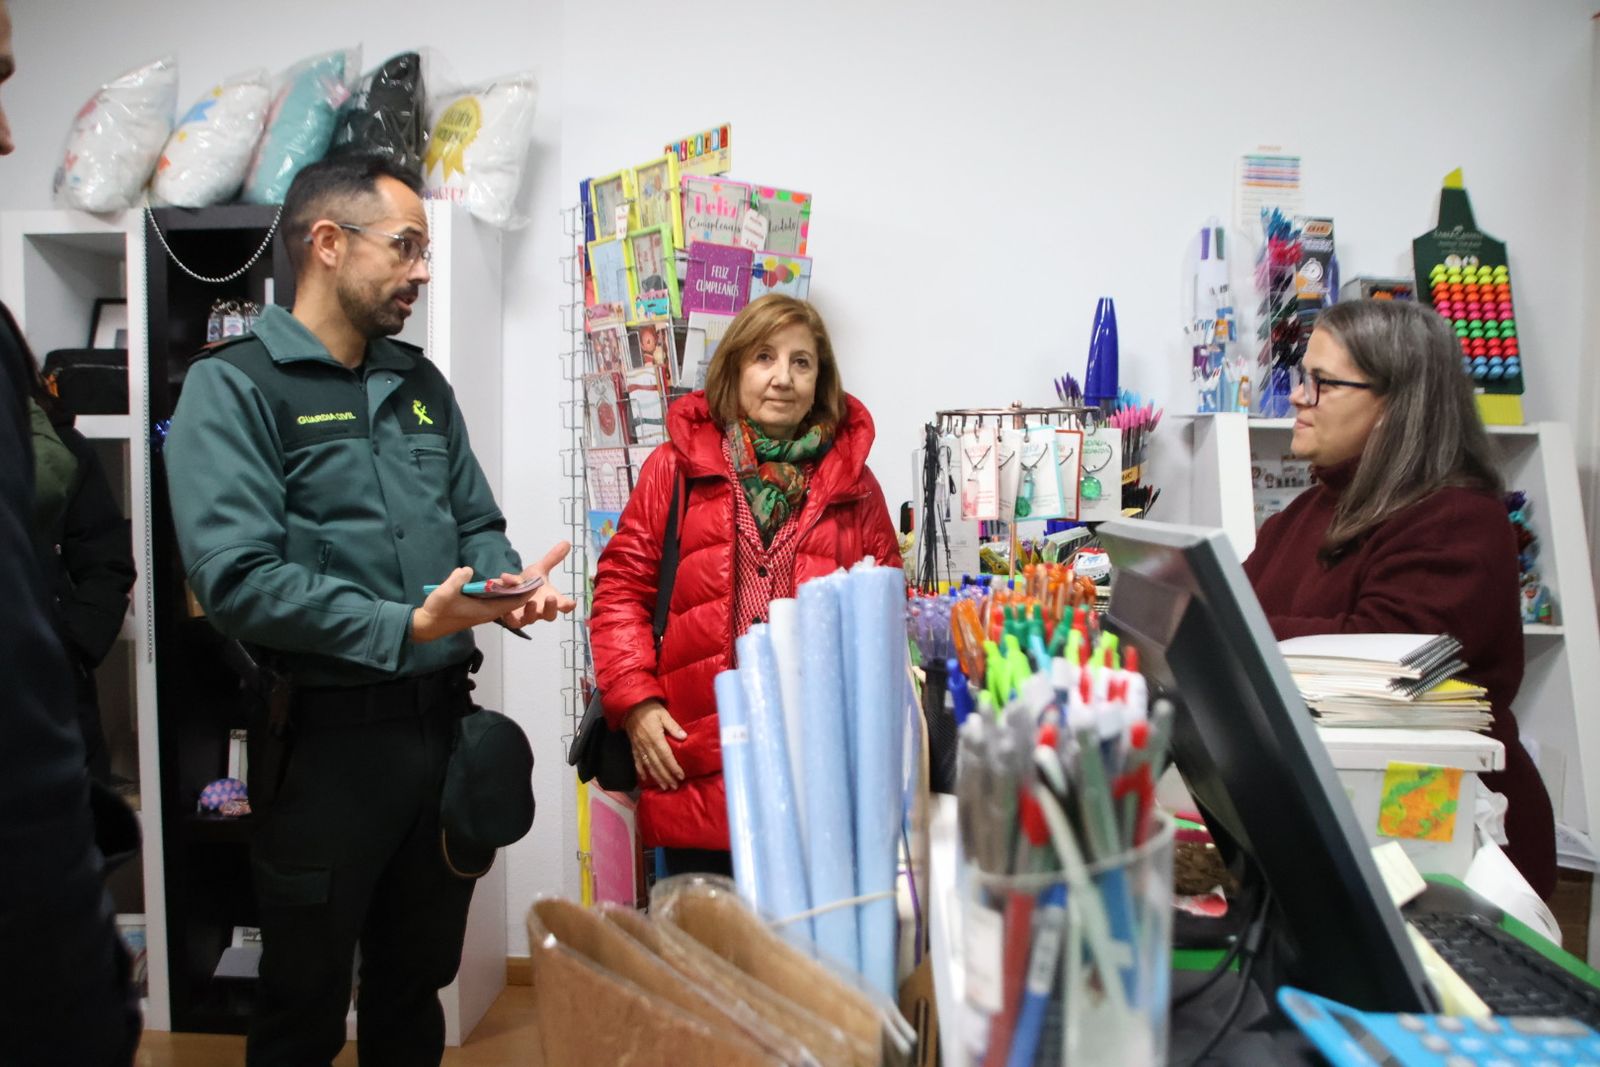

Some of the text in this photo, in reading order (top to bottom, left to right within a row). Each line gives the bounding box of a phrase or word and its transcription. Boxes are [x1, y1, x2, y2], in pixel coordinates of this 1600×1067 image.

[711, 264, 729, 279] FELIZ
[695, 279, 740, 296] CUMPLEAÑOS
[297, 411, 357, 425] GUARDIA CIVIL
